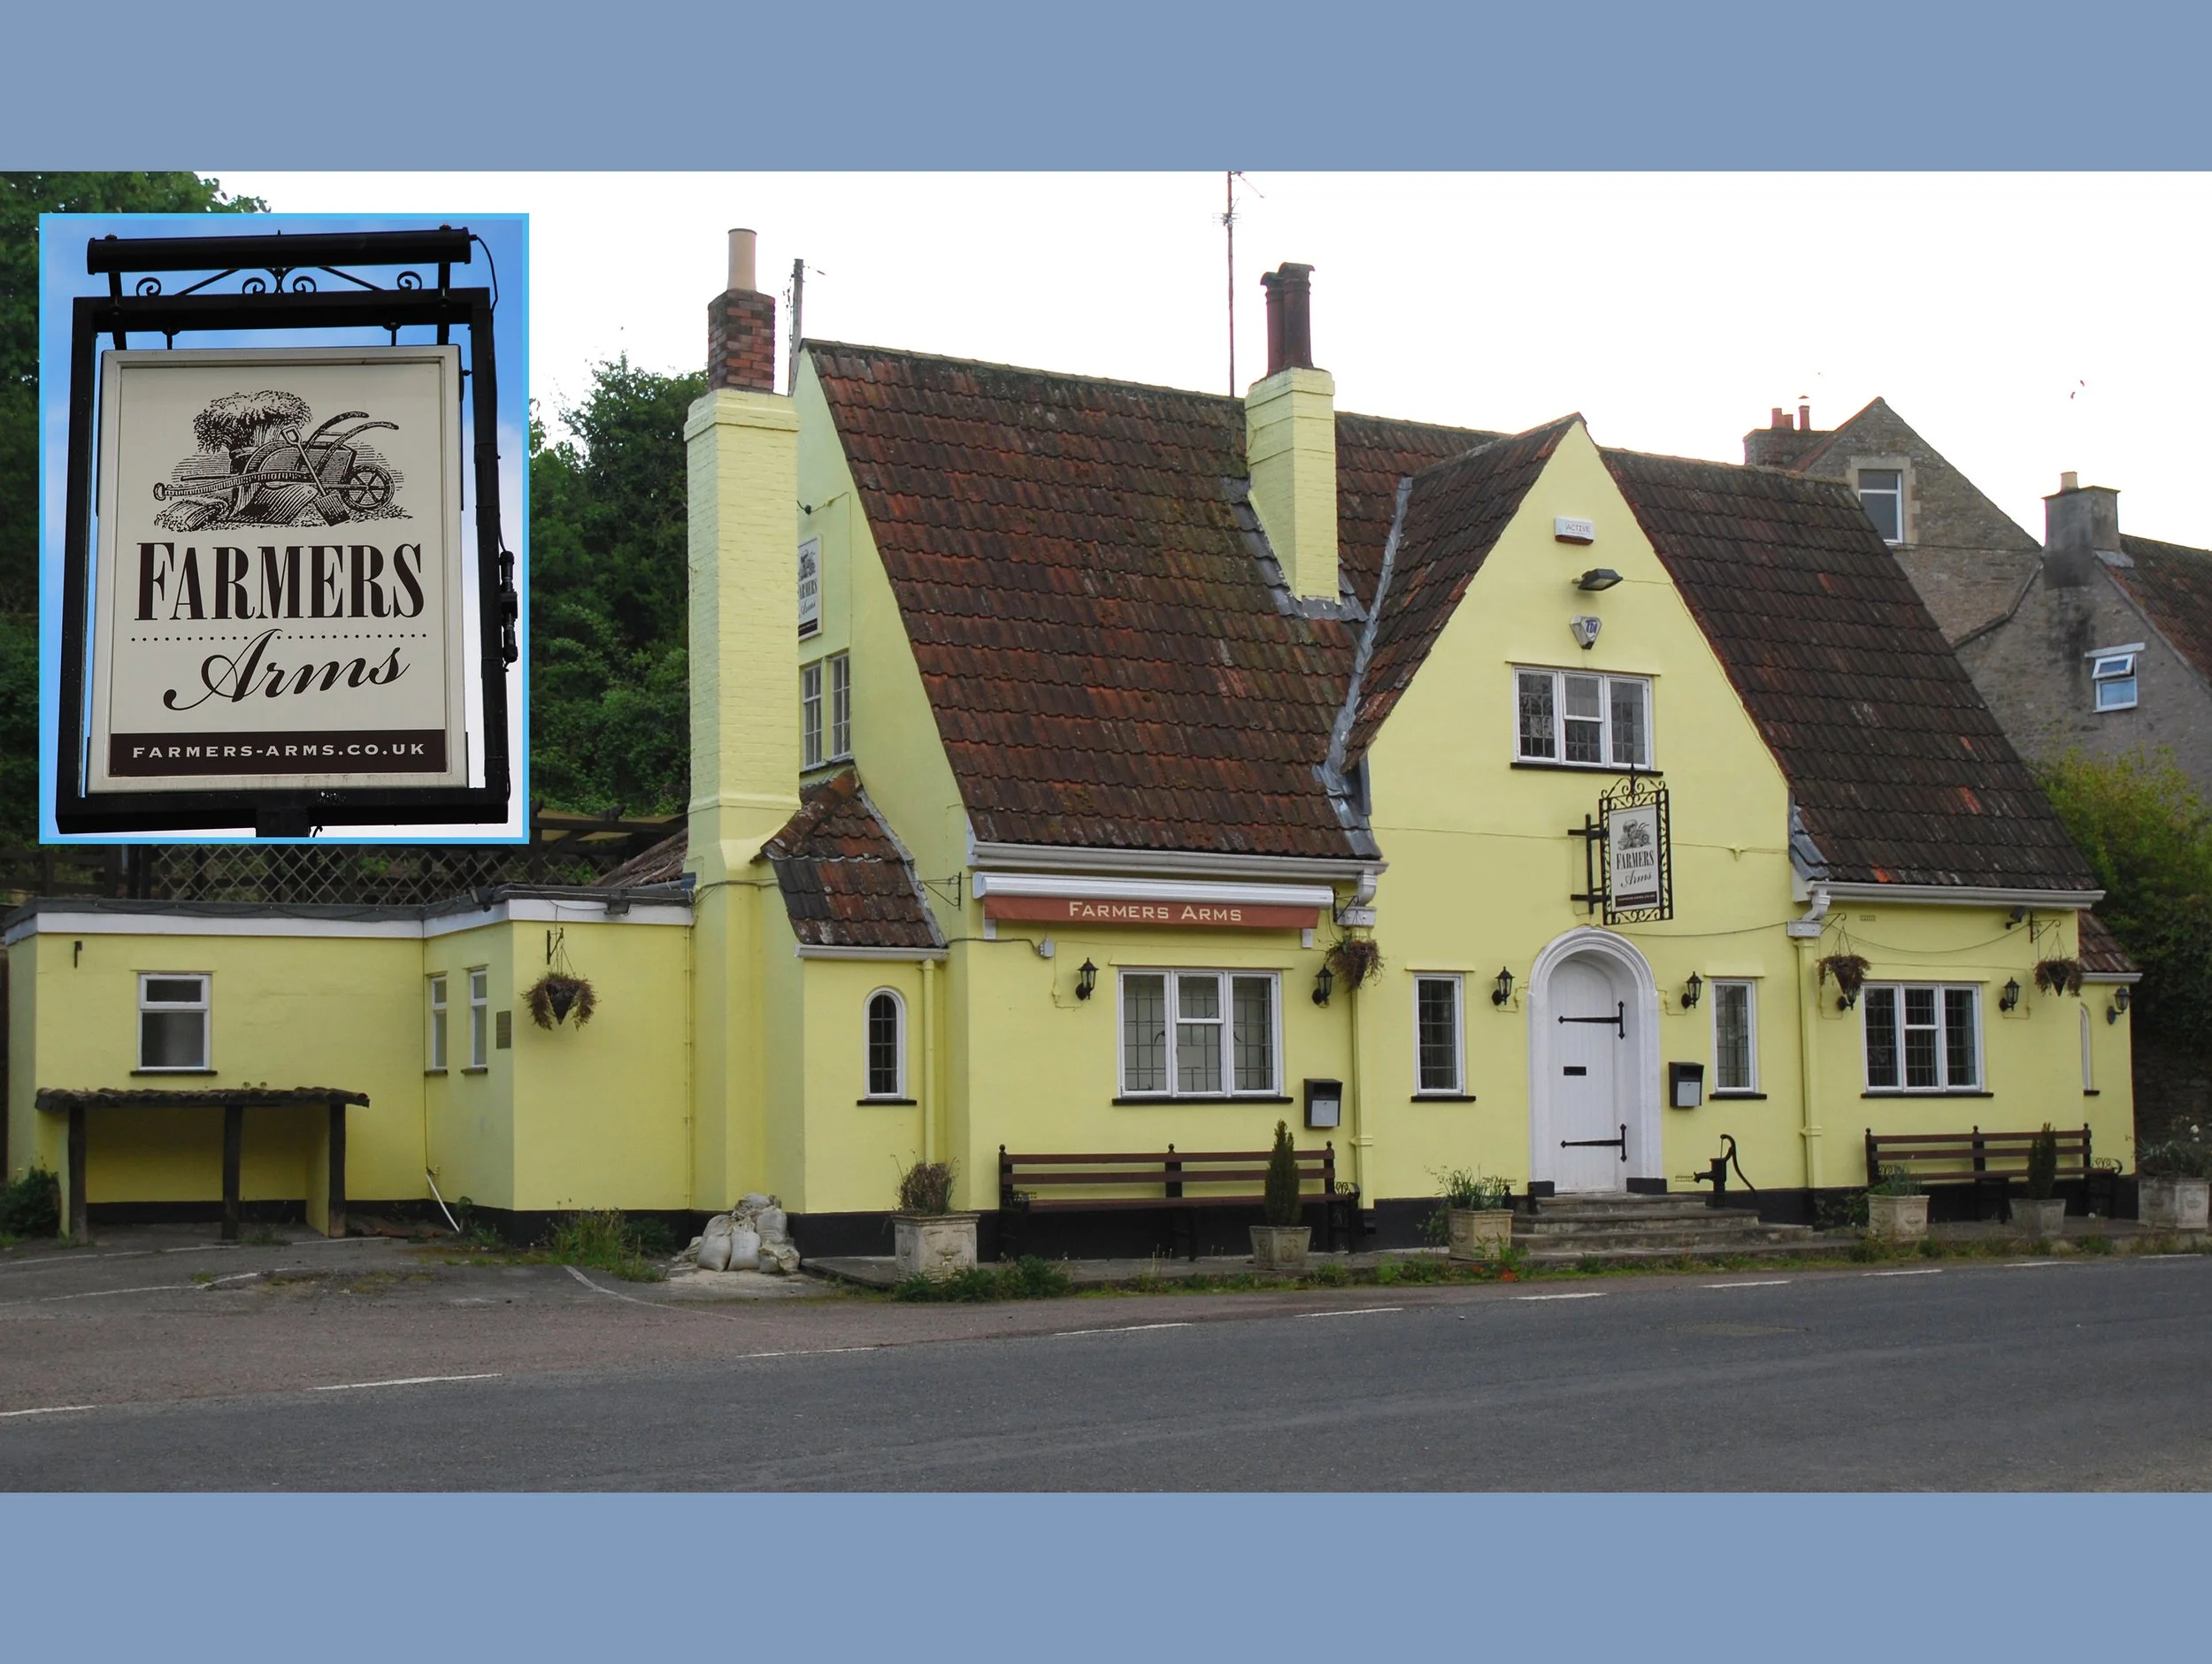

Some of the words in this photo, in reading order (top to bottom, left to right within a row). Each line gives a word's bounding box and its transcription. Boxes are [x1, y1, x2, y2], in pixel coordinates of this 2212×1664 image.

[134, 542, 425, 620] FARMERS
[163, 628, 411, 710] Arms
[133, 743, 426, 758] FARMERS-ARMS.CO.UK
[1617, 850, 1655, 870] FARMERS
[1620, 870, 1652, 887] Arms
[1069, 901, 1169, 919] FARMERS
[1180, 905, 1242, 922] ARMS
